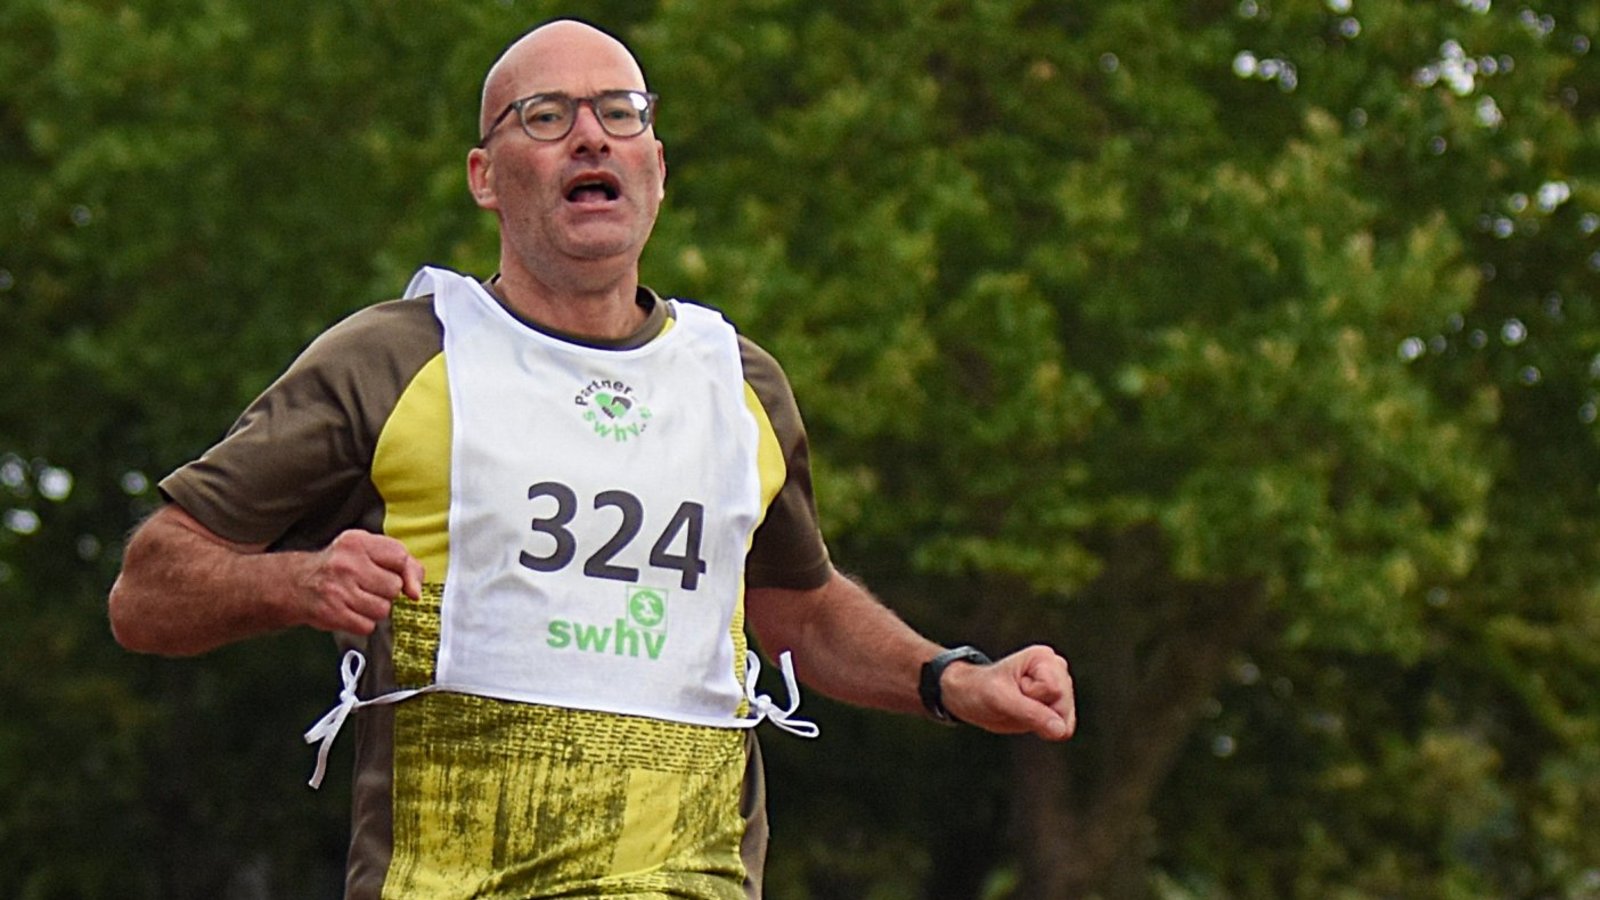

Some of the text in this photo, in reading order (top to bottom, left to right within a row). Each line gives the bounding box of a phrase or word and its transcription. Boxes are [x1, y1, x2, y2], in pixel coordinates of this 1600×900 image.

[574, 379, 633, 407] Partner
[519, 481, 706, 591] 324
[546, 618, 667, 660] swhv
